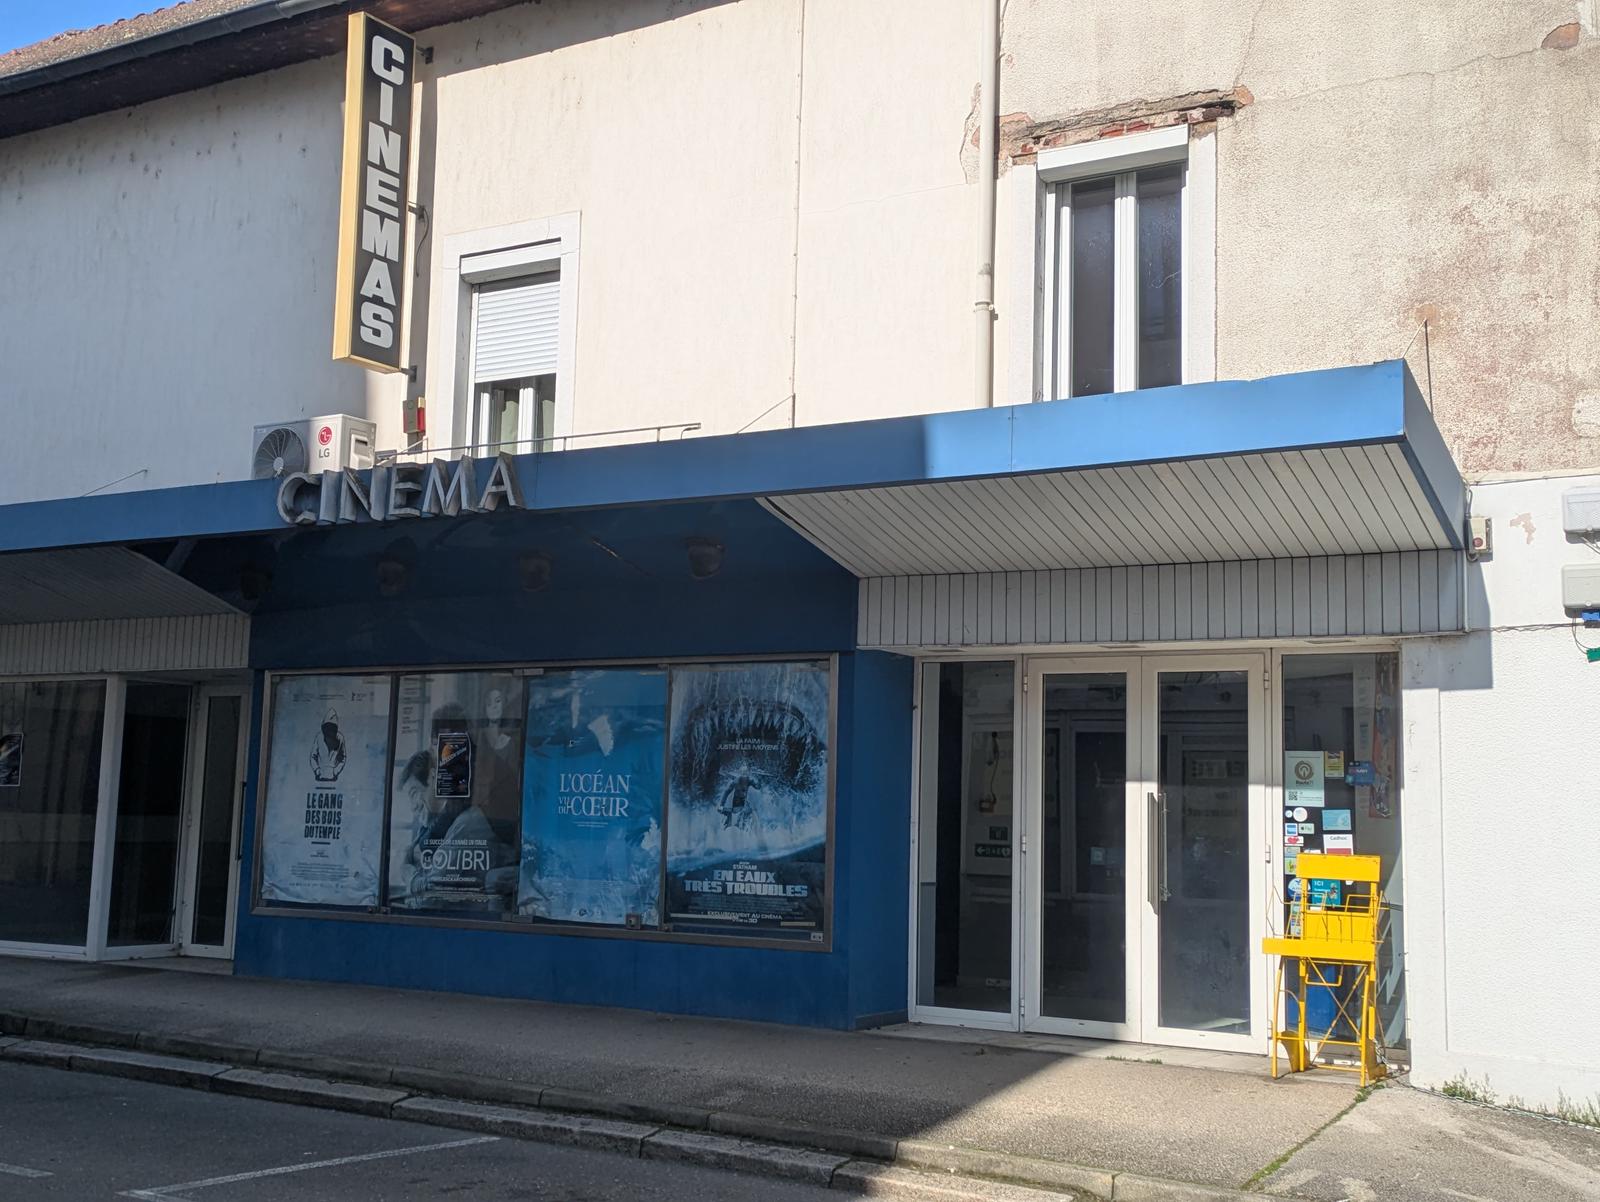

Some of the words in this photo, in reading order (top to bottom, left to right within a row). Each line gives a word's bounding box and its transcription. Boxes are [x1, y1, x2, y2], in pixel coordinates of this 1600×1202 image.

[360, 34, 405, 349] CINEMAS
[318, 448, 330, 458] LG
[276, 451, 528, 525] CINEMA
[559, 768, 632, 794] L'OCÉAN
[306, 793, 317, 809] LE
[318, 793, 343, 809] GANG
[305, 810, 320, 824] DES
[322, 810, 342, 825] BOIS
[304, 825, 315, 838] DU
[315, 826, 341, 839] TEMPLE
[420, 849, 490, 870] COLIBRI
[712, 869, 734, 881] EN
[736, 870, 776, 883] EAUX
[684, 878, 723, 893] TRÈS
[725, 882, 808, 897] TROUBLES
